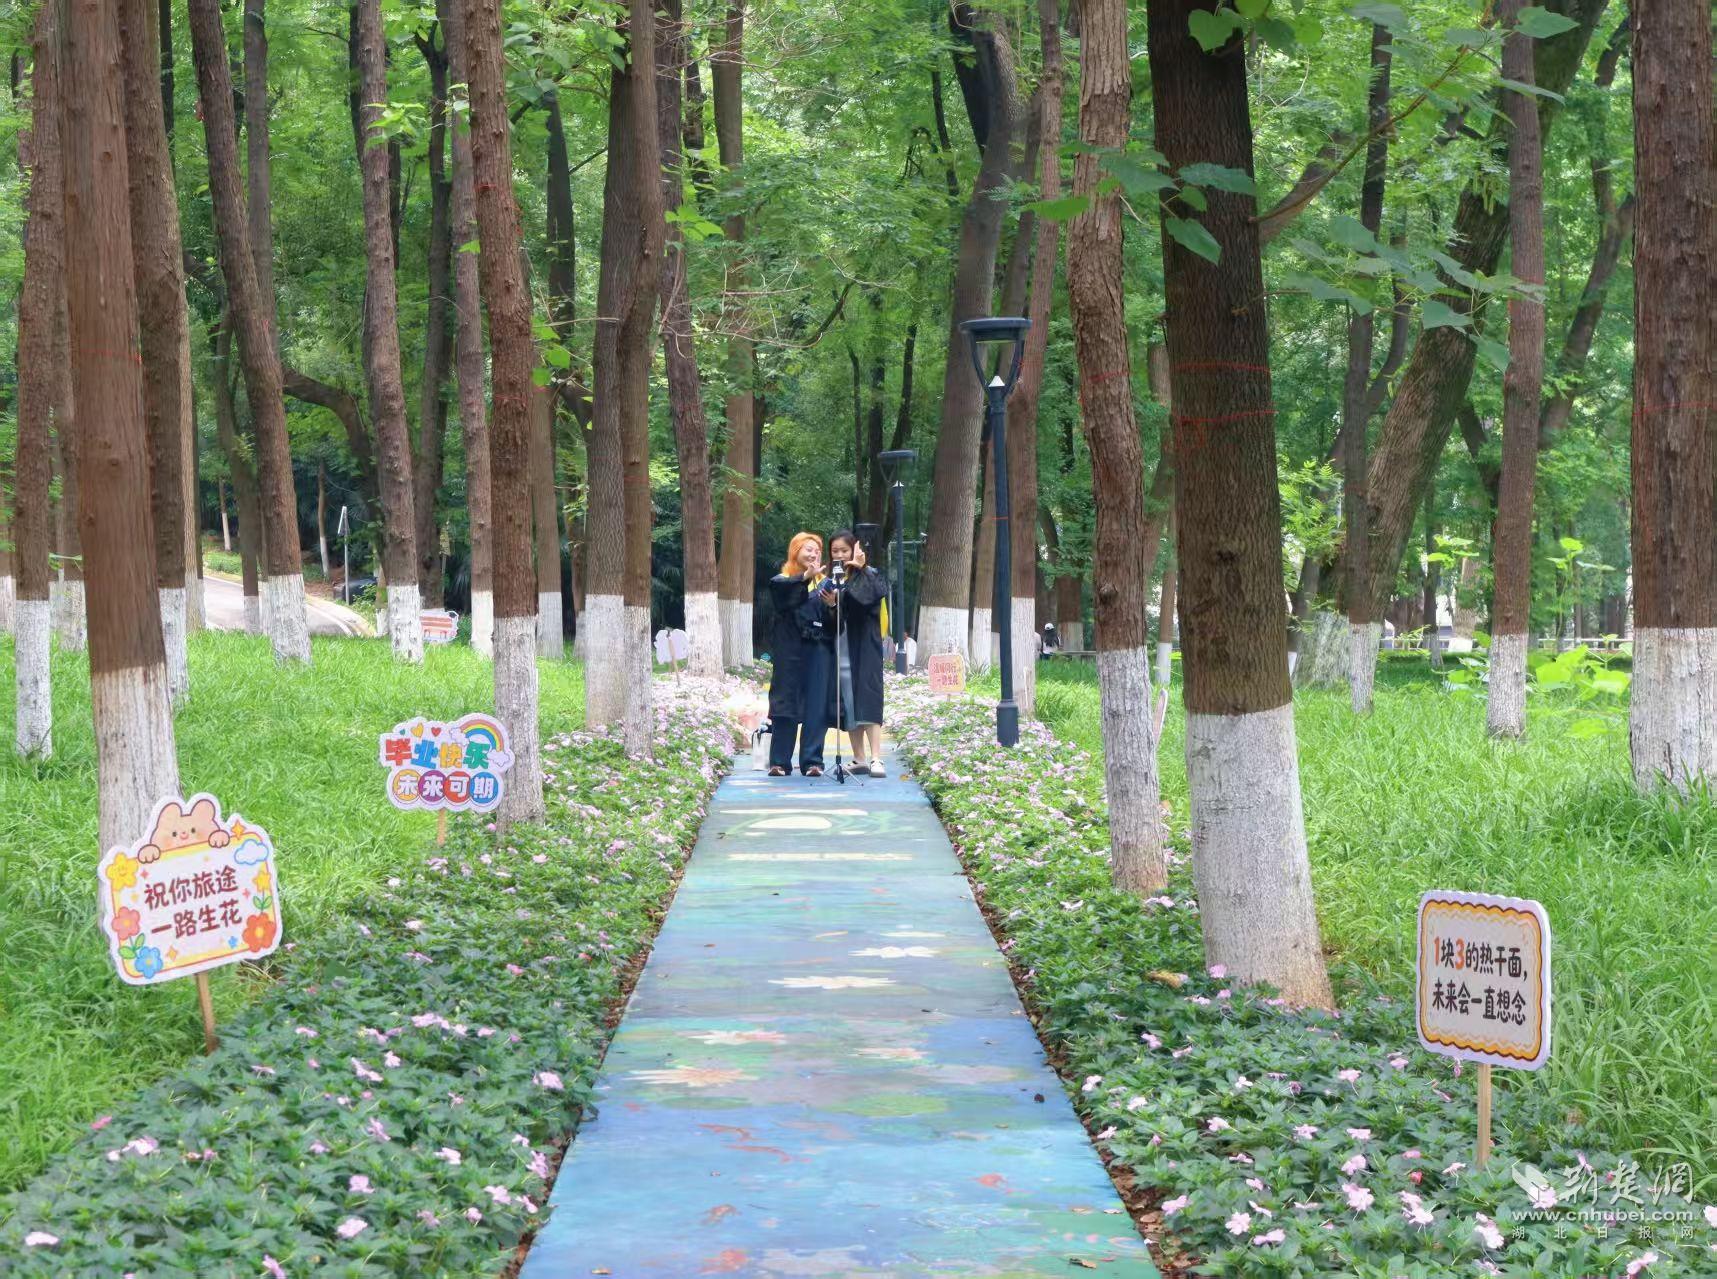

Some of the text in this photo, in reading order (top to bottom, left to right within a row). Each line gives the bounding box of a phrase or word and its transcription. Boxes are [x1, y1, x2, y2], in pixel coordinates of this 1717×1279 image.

[385, 738, 490, 769] 毕业快乐
[144, 864, 238, 910] 祝你旅途
[151, 899, 242, 939] 一路生花
[1432, 977, 1526, 1026] 未来会一直想念
